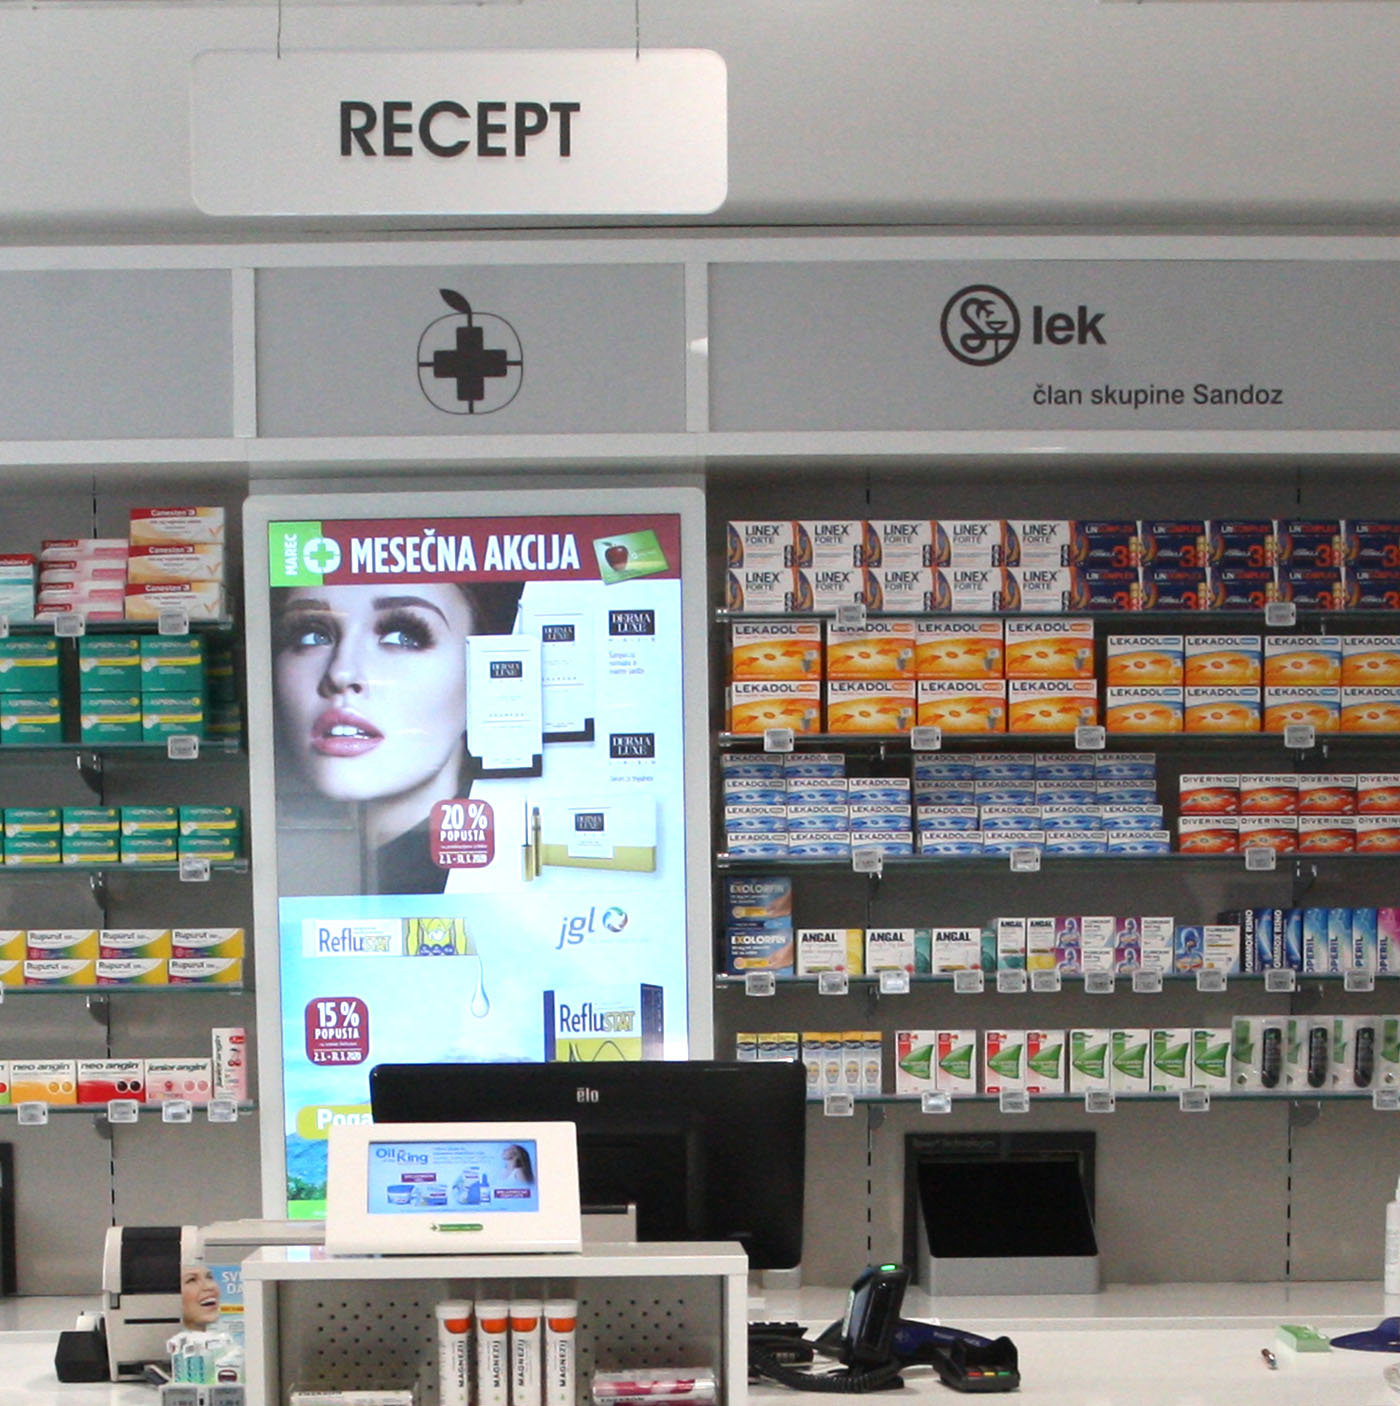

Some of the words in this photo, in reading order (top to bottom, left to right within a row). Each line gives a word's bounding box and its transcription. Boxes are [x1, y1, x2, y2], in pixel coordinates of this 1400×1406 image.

[338, 101, 581, 157] RECEPT
[1032, 303, 1106, 346] lek
[1032, 384, 1083, 406] član
[1090, 384, 1184, 410] skupine
[1192, 383, 1283, 406] Sandoz
[745, 524, 779, 536] LINEX
[815, 524, 849, 536] LINEX
[884, 524, 918, 536] LINEX
[953, 524, 987, 536] LINEX
[1022, 524, 1057, 536] LINEX
[284, 534, 297, 575] MAREC
[351, 529, 477, 574] MESEČNA
[484, 534, 580, 571] AKCIJA
[745, 571, 779, 583] LINEX
[815, 571, 849, 583] LINEX
[145, 584, 181, 592] Canesten
[612, 614, 651, 623] DERMA
[617, 623, 647, 633] LUXE
[736, 625, 796, 634] LEKADOL
[918, 623, 978, 633] LEKADOL
[1008, 623, 1068, 633] LEKADOL
[1110, 638, 1162, 646] LEKADOL
[1188, 638, 1240, 646] LEKADOL
[1344, 638, 1396, 646] LEKADOL
[736, 683, 796, 693] LEKADOL
[831, 682, 891, 692] LEKADOL
[613, 737, 651, 746] DERMA
[618, 746, 647, 756] LUXE
[441, 804, 464, 829] 20
[469, 804, 487, 829] %
[440, 830, 485, 841] POPUSTA
[555, 907, 595, 949] jgl
[317, 1002, 336, 1027] 15
[340, 1002, 359, 1027] %
[315, 1028, 359, 1039] POPUSTA
[38, 1063, 70, 1073] angin
[106, 1062, 139, 1070] angin
[376, 1148, 395, 1158] Oil
